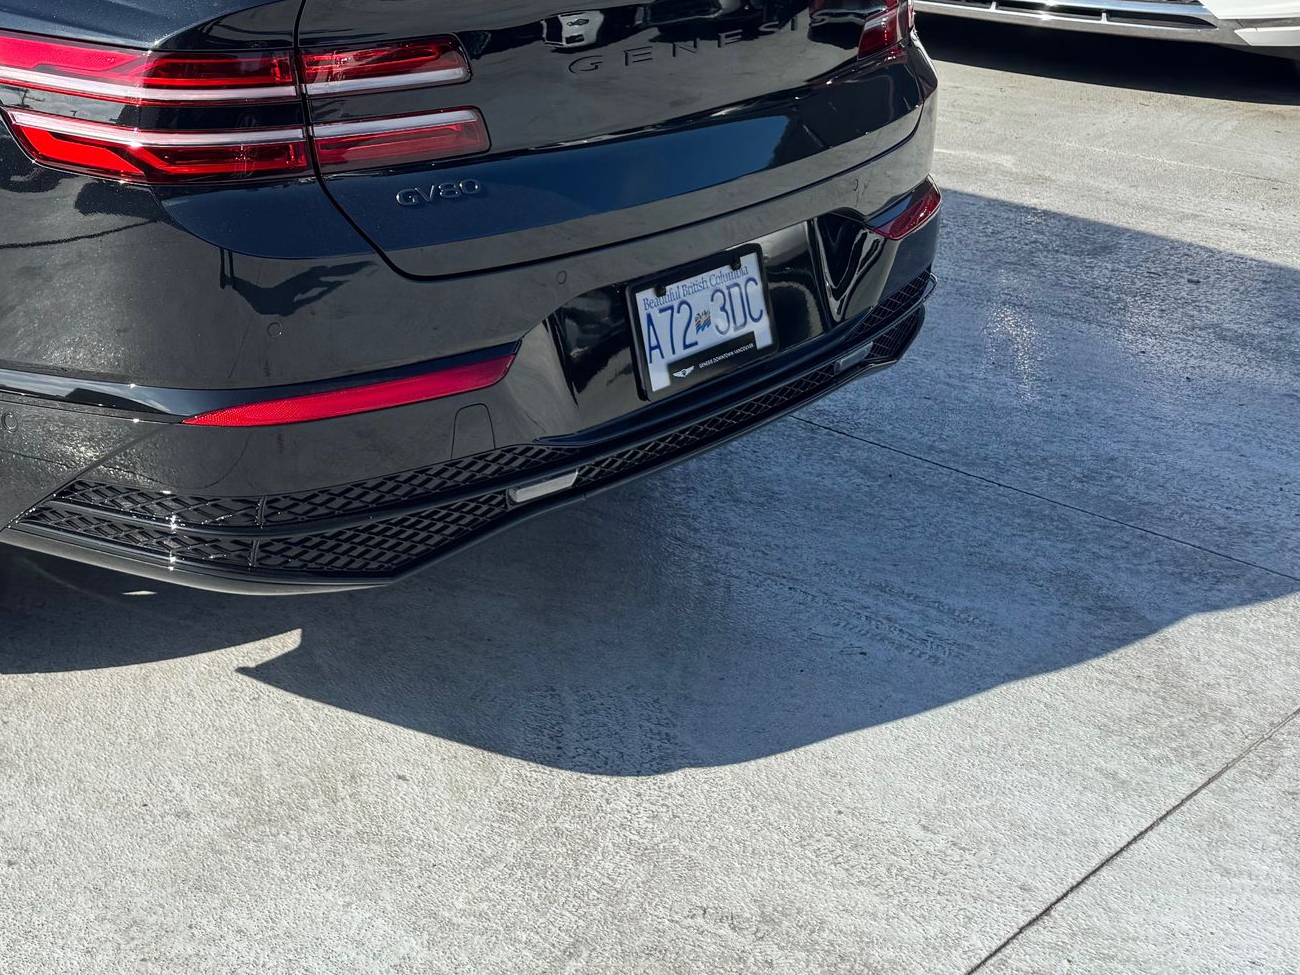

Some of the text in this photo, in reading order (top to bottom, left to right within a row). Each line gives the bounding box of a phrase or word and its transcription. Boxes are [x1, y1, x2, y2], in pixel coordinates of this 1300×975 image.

[395, 178, 481, 206] GV80
[681, 276, 708, 298] British
[708, 265, 750, 288] Columbia
[646, 276, 764, 364] A72 3DC
